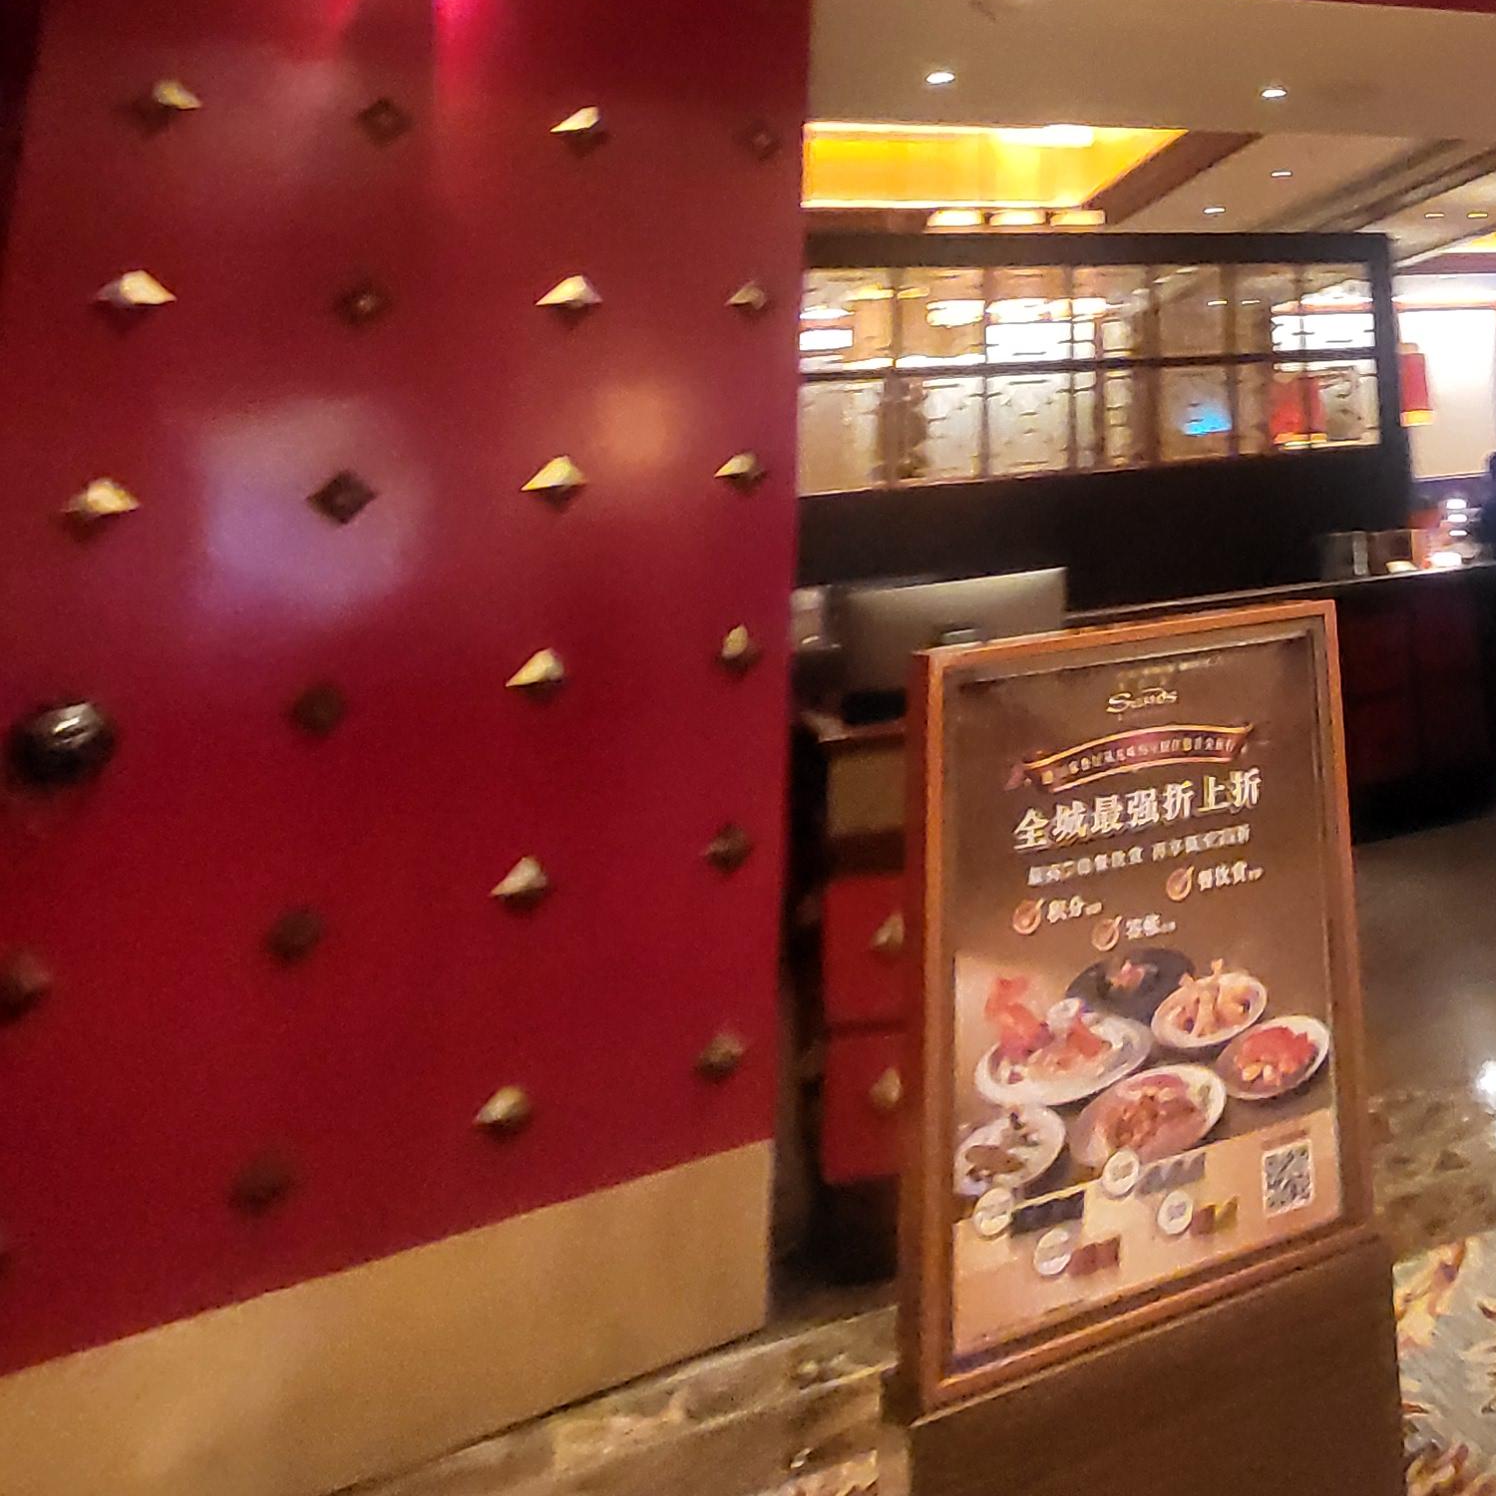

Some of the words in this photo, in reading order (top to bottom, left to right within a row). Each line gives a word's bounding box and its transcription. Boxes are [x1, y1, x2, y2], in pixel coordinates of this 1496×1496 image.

[1012, 768, 1263, 852] 全城最强折上折
